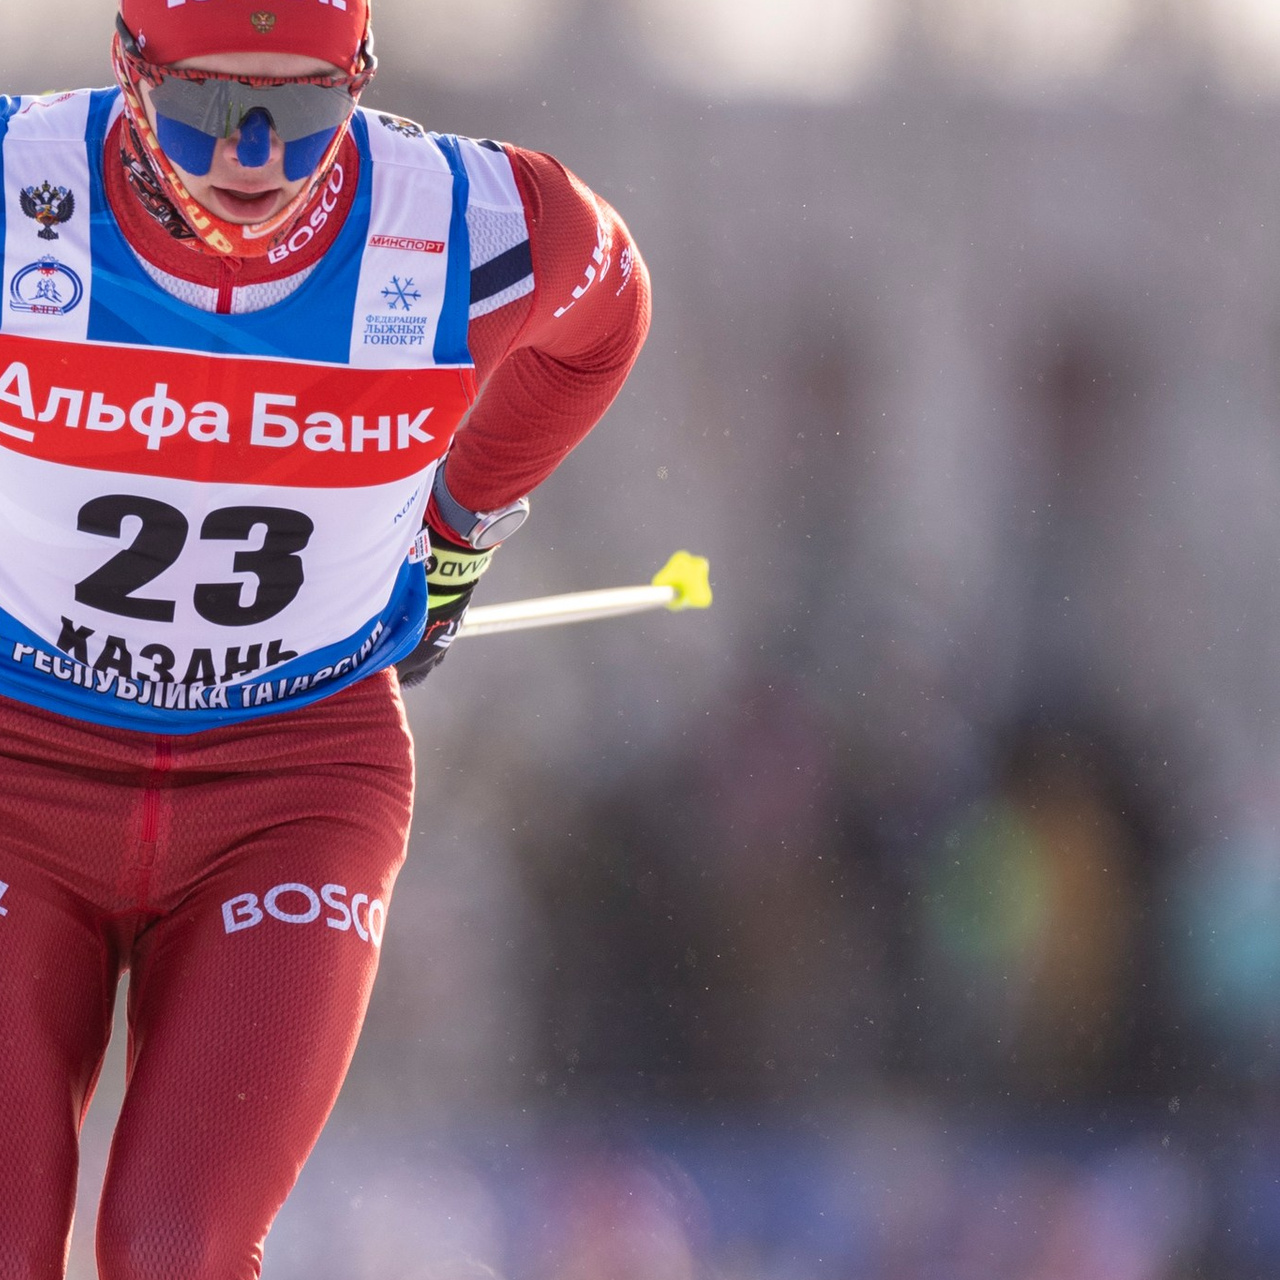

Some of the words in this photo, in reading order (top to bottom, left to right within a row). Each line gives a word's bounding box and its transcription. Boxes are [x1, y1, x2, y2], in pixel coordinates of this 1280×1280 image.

[267, 163, 345, 264] BOSCO
[370, 235, 444, 253] МИНСПОРТ
[363, 324, 425, 335] ЛЫЖНЫХ
[363, 335, 408, 345] ГОНОК
[409, 335, 425, 346] РТ
[365, 314, 428, 325] ФЕДЕРАЦИЯ
[250, 392, 436, 454] Банк
[74, 493, 315, 627] 23
[56, 614, 299, 687] КАЗАНЬ
[221, 882, 385, 949] BOSCO
